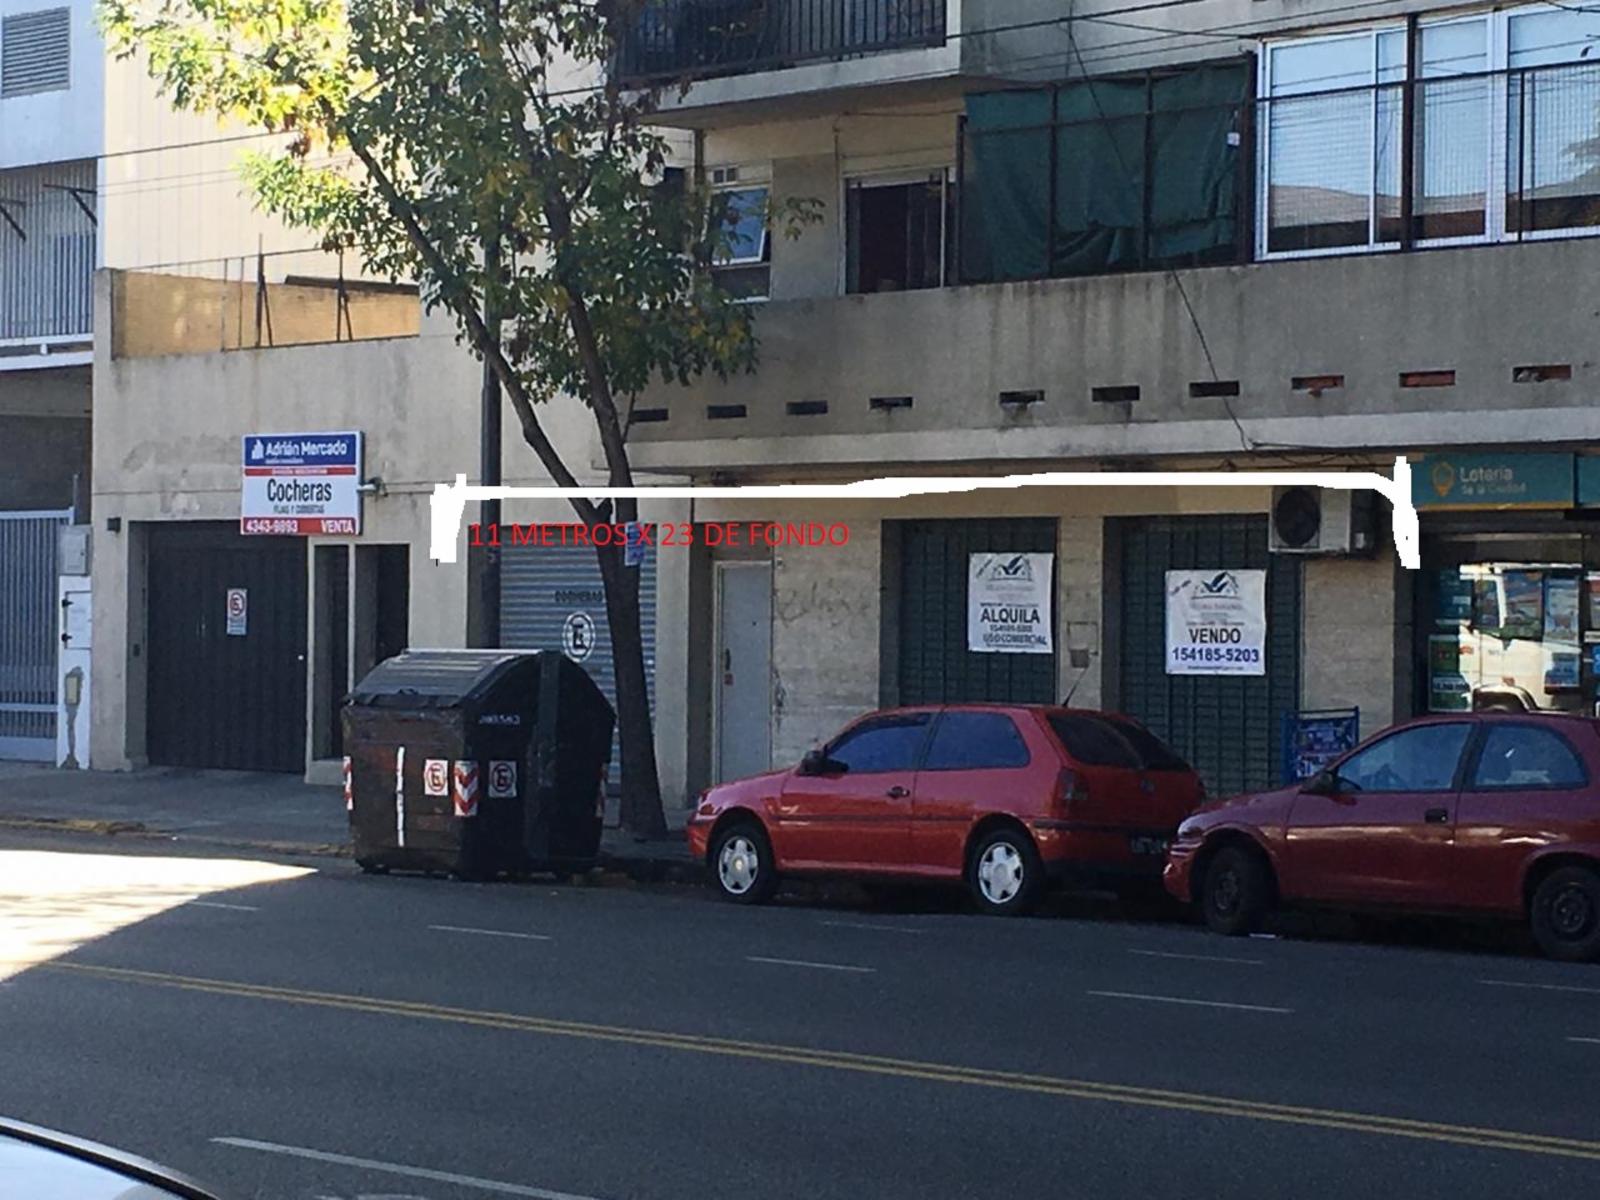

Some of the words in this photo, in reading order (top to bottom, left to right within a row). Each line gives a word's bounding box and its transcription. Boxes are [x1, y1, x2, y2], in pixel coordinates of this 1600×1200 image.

[301, 440, 347, 456] Mercado
[267, 478, 332, 502] Cocheras
[321, 519, 355, 533] VENTA
[980, 607, 1041, 624] ALQUILA
[1189, 627, 1242, 644] VENDO
